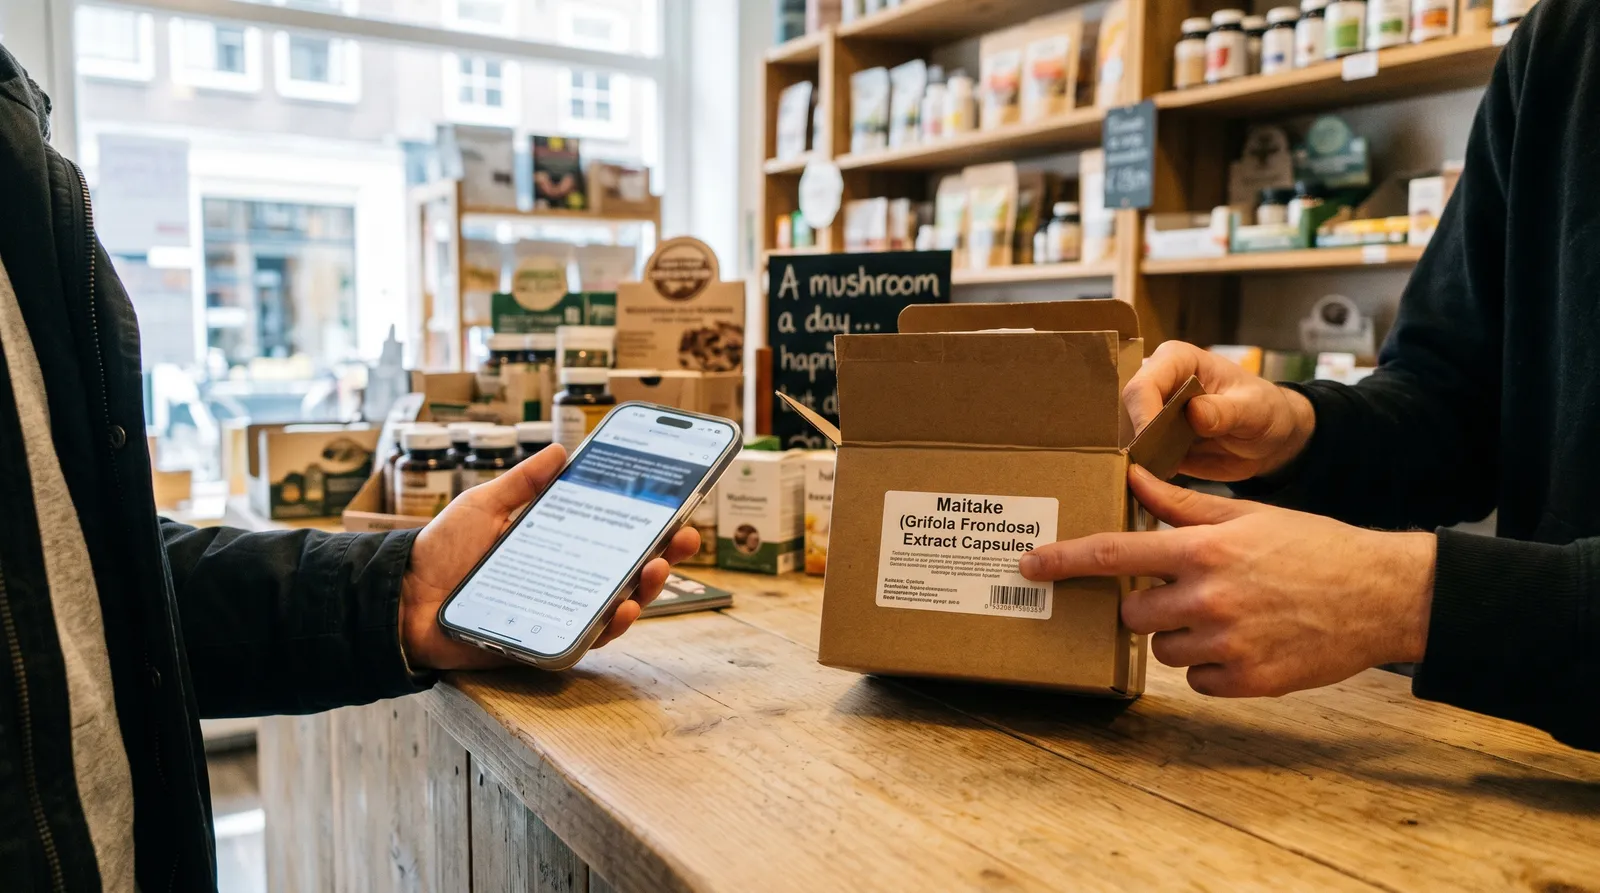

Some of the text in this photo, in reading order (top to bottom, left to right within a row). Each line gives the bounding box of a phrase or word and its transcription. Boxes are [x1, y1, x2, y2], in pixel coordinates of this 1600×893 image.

[778, 264, 940, 300] A mushroom
[777, 311, 796, 333] a
[936, 497, 1003, 514] Maitake
[900, 514, 1040, 538] (Grifola Frondosa)
[903, 532, 1034, 553] Extract Capsules
